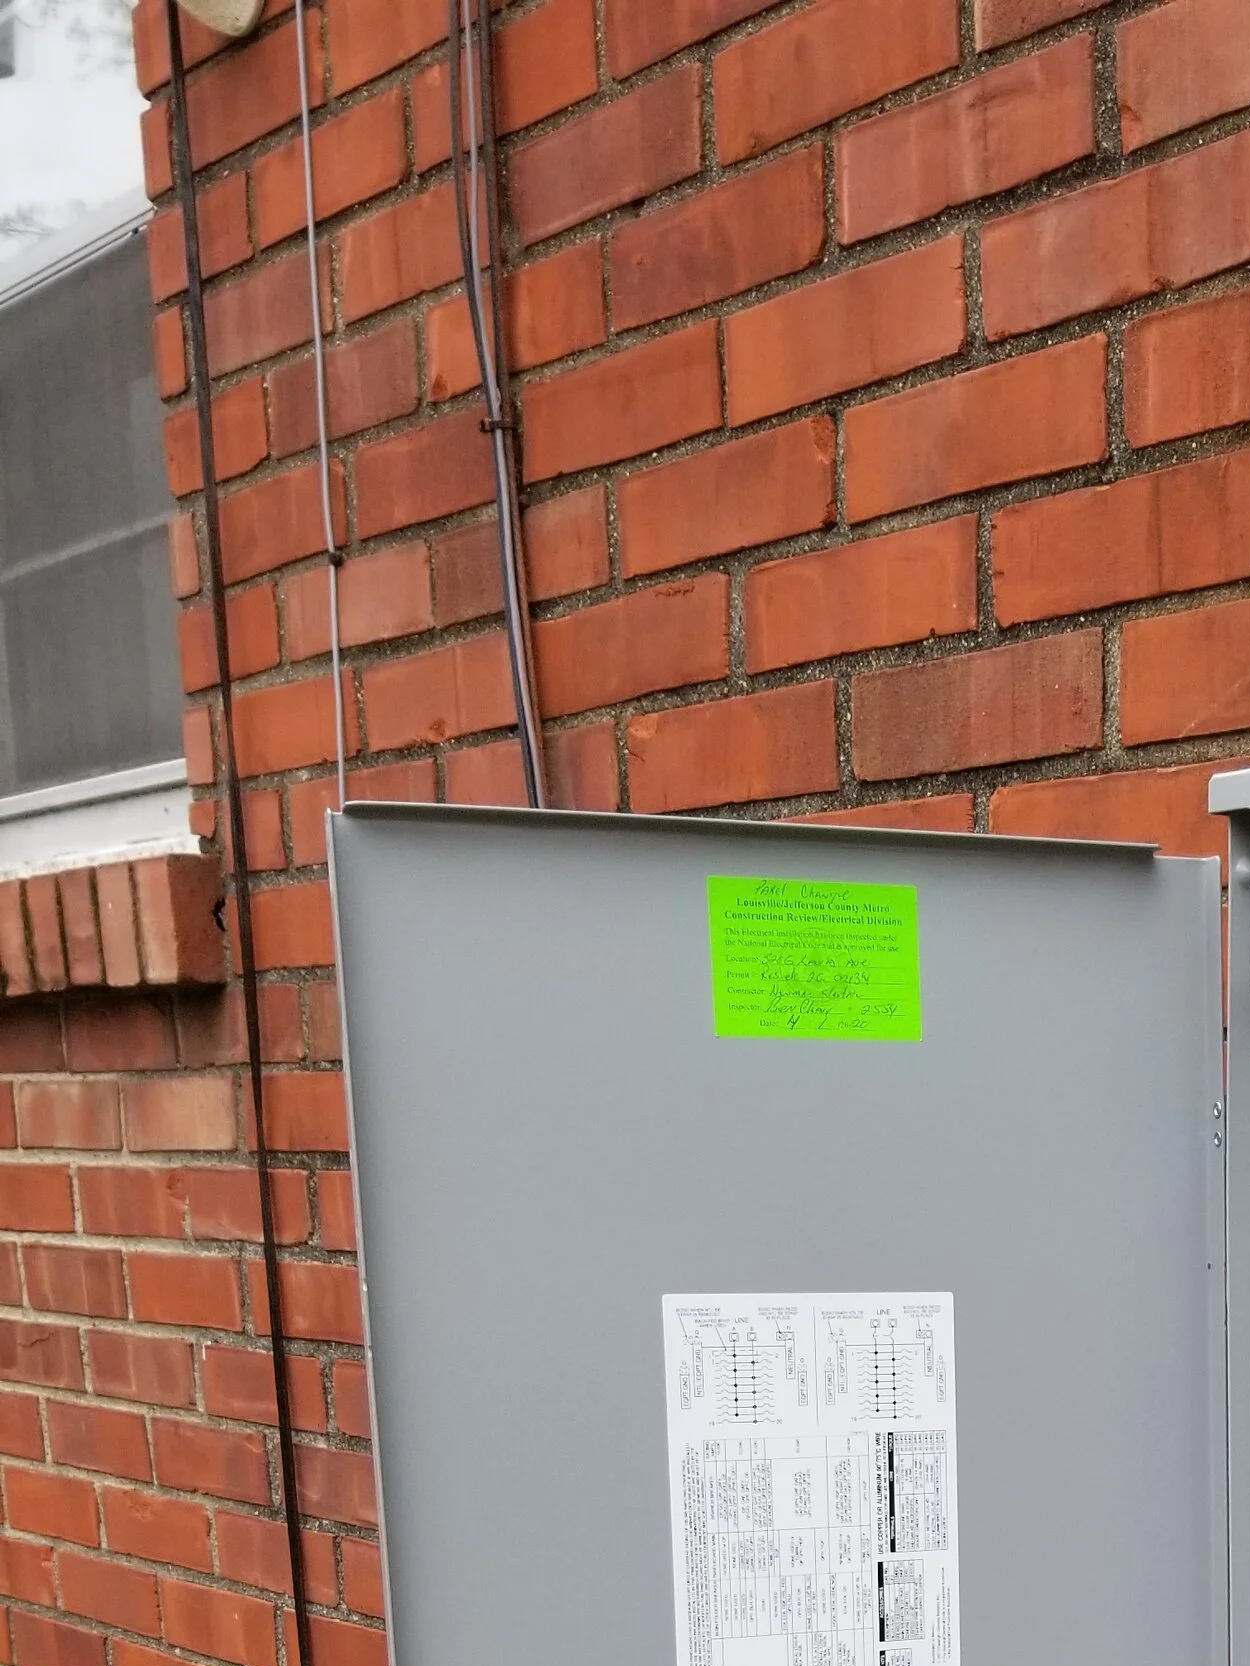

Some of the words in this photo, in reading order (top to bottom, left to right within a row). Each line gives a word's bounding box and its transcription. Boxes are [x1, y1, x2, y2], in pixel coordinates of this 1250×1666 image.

[736, 898, 825, 910] Louisville/Jefferson
[827, 902, 860, 913] County
[863, 903, 890, 913] Metro
[724, 910, 784, 922] Construction
[786, 912, 864, 925] Review/Electrical
[866, 917, 903, 927] Division
[725, 927, 741, 936] This
[742, 928, 775, 938] Electrical
[737, 940, 768, 948] National
[876, 1505, 883, 1516] OR
[876, 1517, 884, 1541] COPPER
